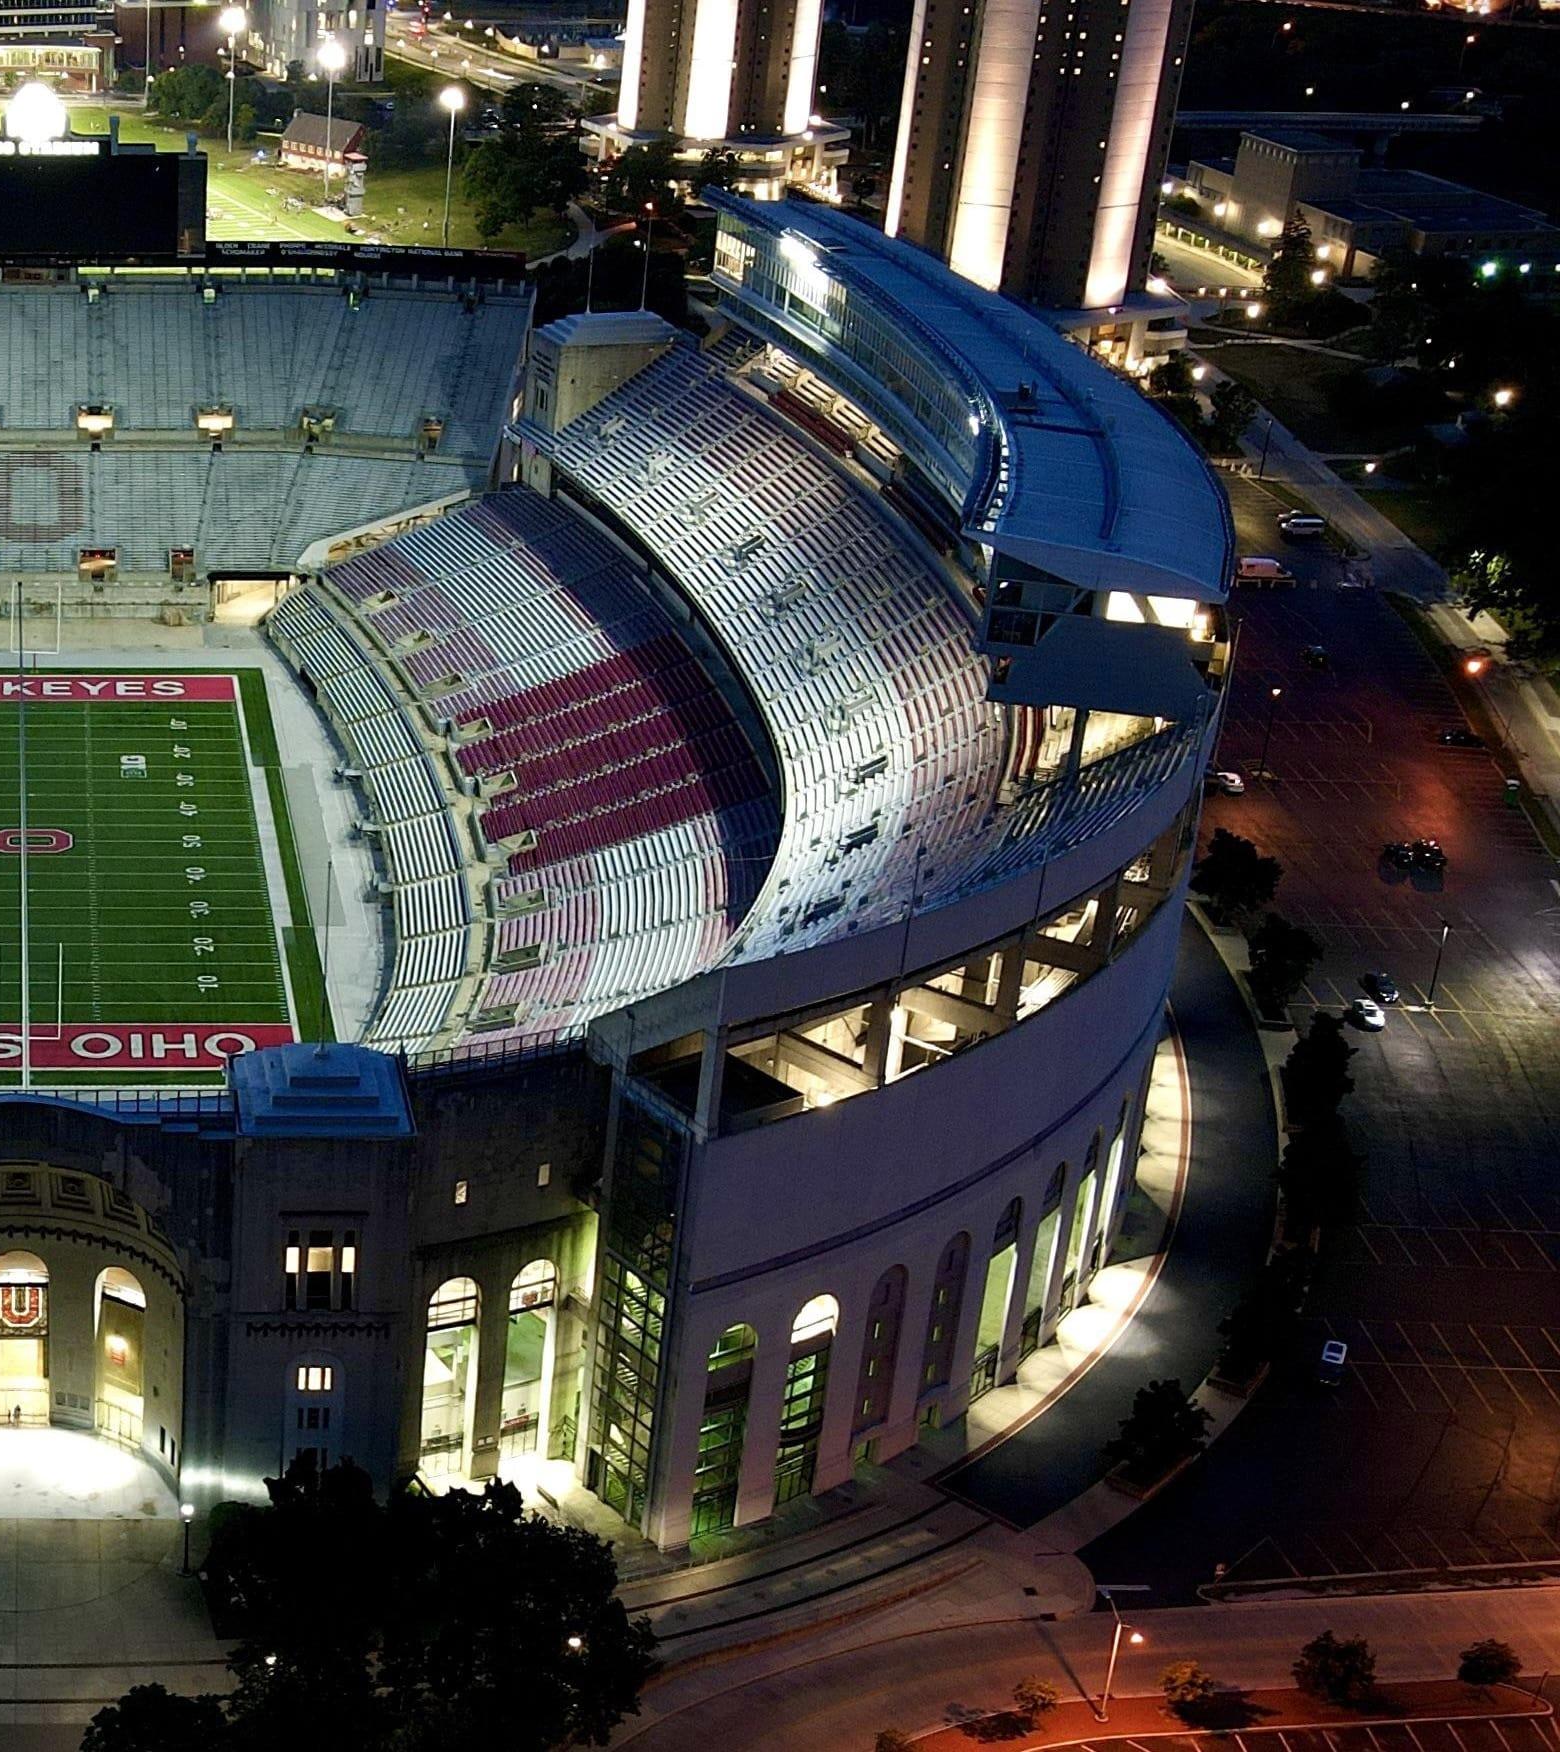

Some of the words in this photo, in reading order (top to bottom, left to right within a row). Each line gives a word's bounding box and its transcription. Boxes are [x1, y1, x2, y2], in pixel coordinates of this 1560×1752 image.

[182, 835, 202, 848] 50
[189, 901, 210, 916] 30
[193, 937, 214, 952] 20
[197, 975, 219, 989] 10
[70, 1032, 257, 1059] OHIO
